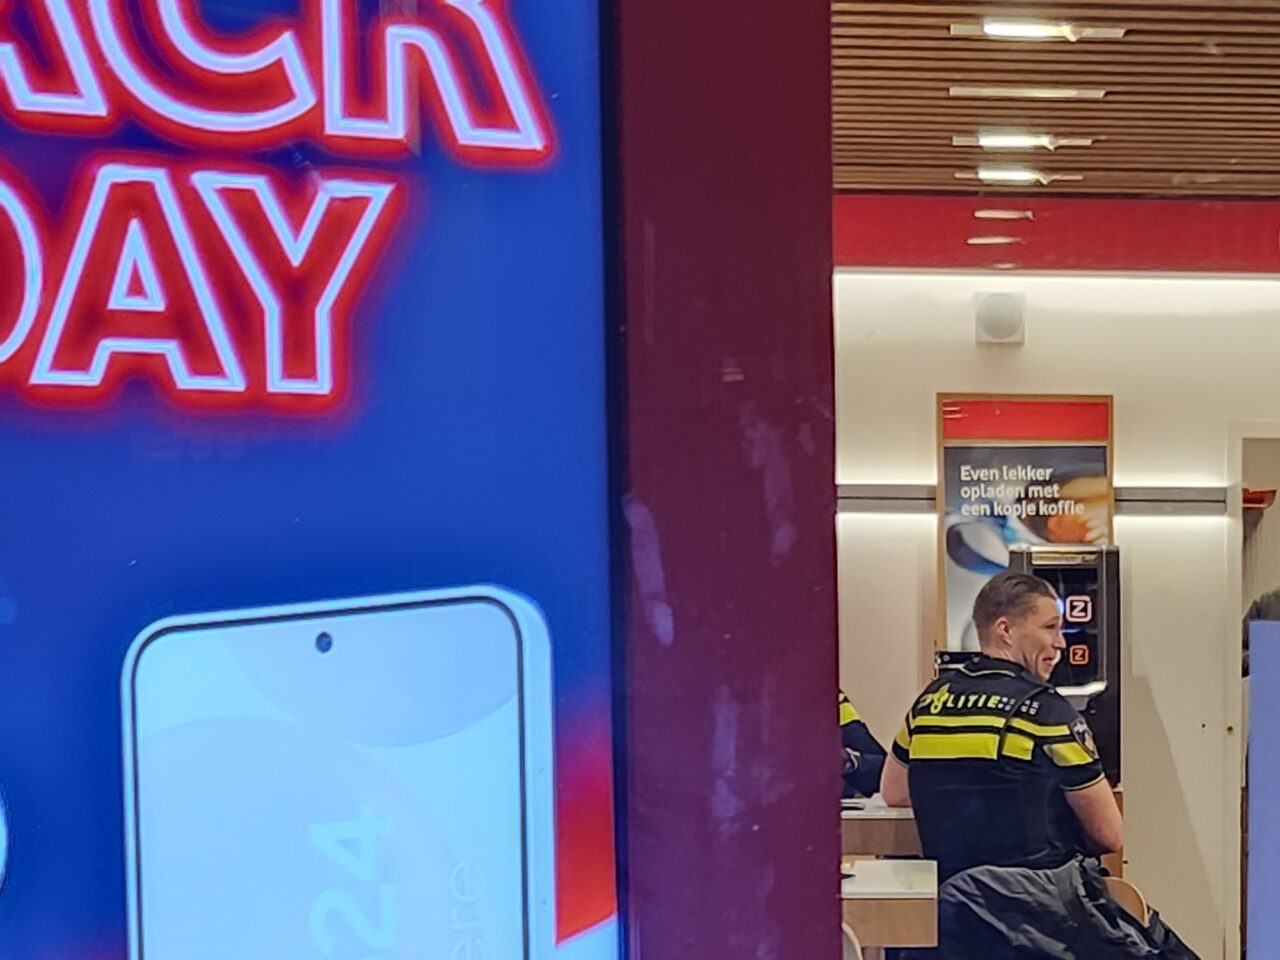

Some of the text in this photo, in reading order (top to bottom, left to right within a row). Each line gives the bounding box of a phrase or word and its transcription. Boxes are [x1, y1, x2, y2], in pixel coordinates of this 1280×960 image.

[0, 163, 397, 395] AY
[960, 465, 1053, 482] Even lekker
[960, 483, 1060, 501] opladen met
[961, 500, 1085, 519] een kopje koffie
